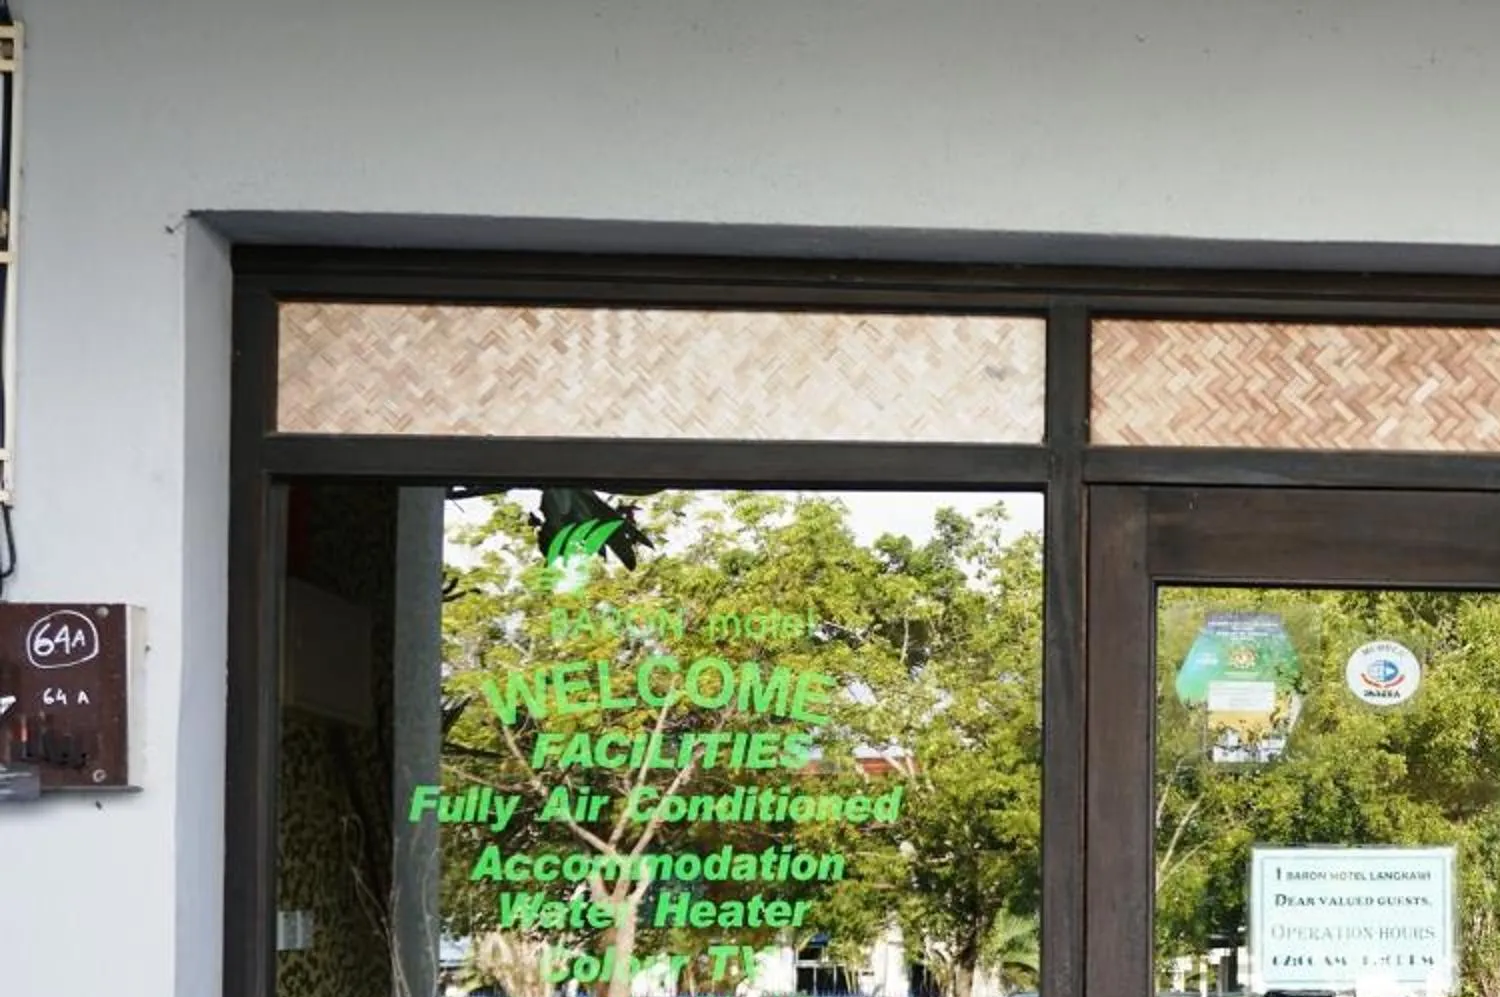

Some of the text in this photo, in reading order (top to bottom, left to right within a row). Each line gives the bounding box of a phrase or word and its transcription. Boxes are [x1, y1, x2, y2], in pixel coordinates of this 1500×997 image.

[481, 654, 838, 726] WELCOME
[531, 732, 818, 770] FACILITIES
[408, 785, 903, 832] Fully Air Conditioned
[470, 845, 845, 882] Accommodation
[500, 891, 813, 928] Water Heater
